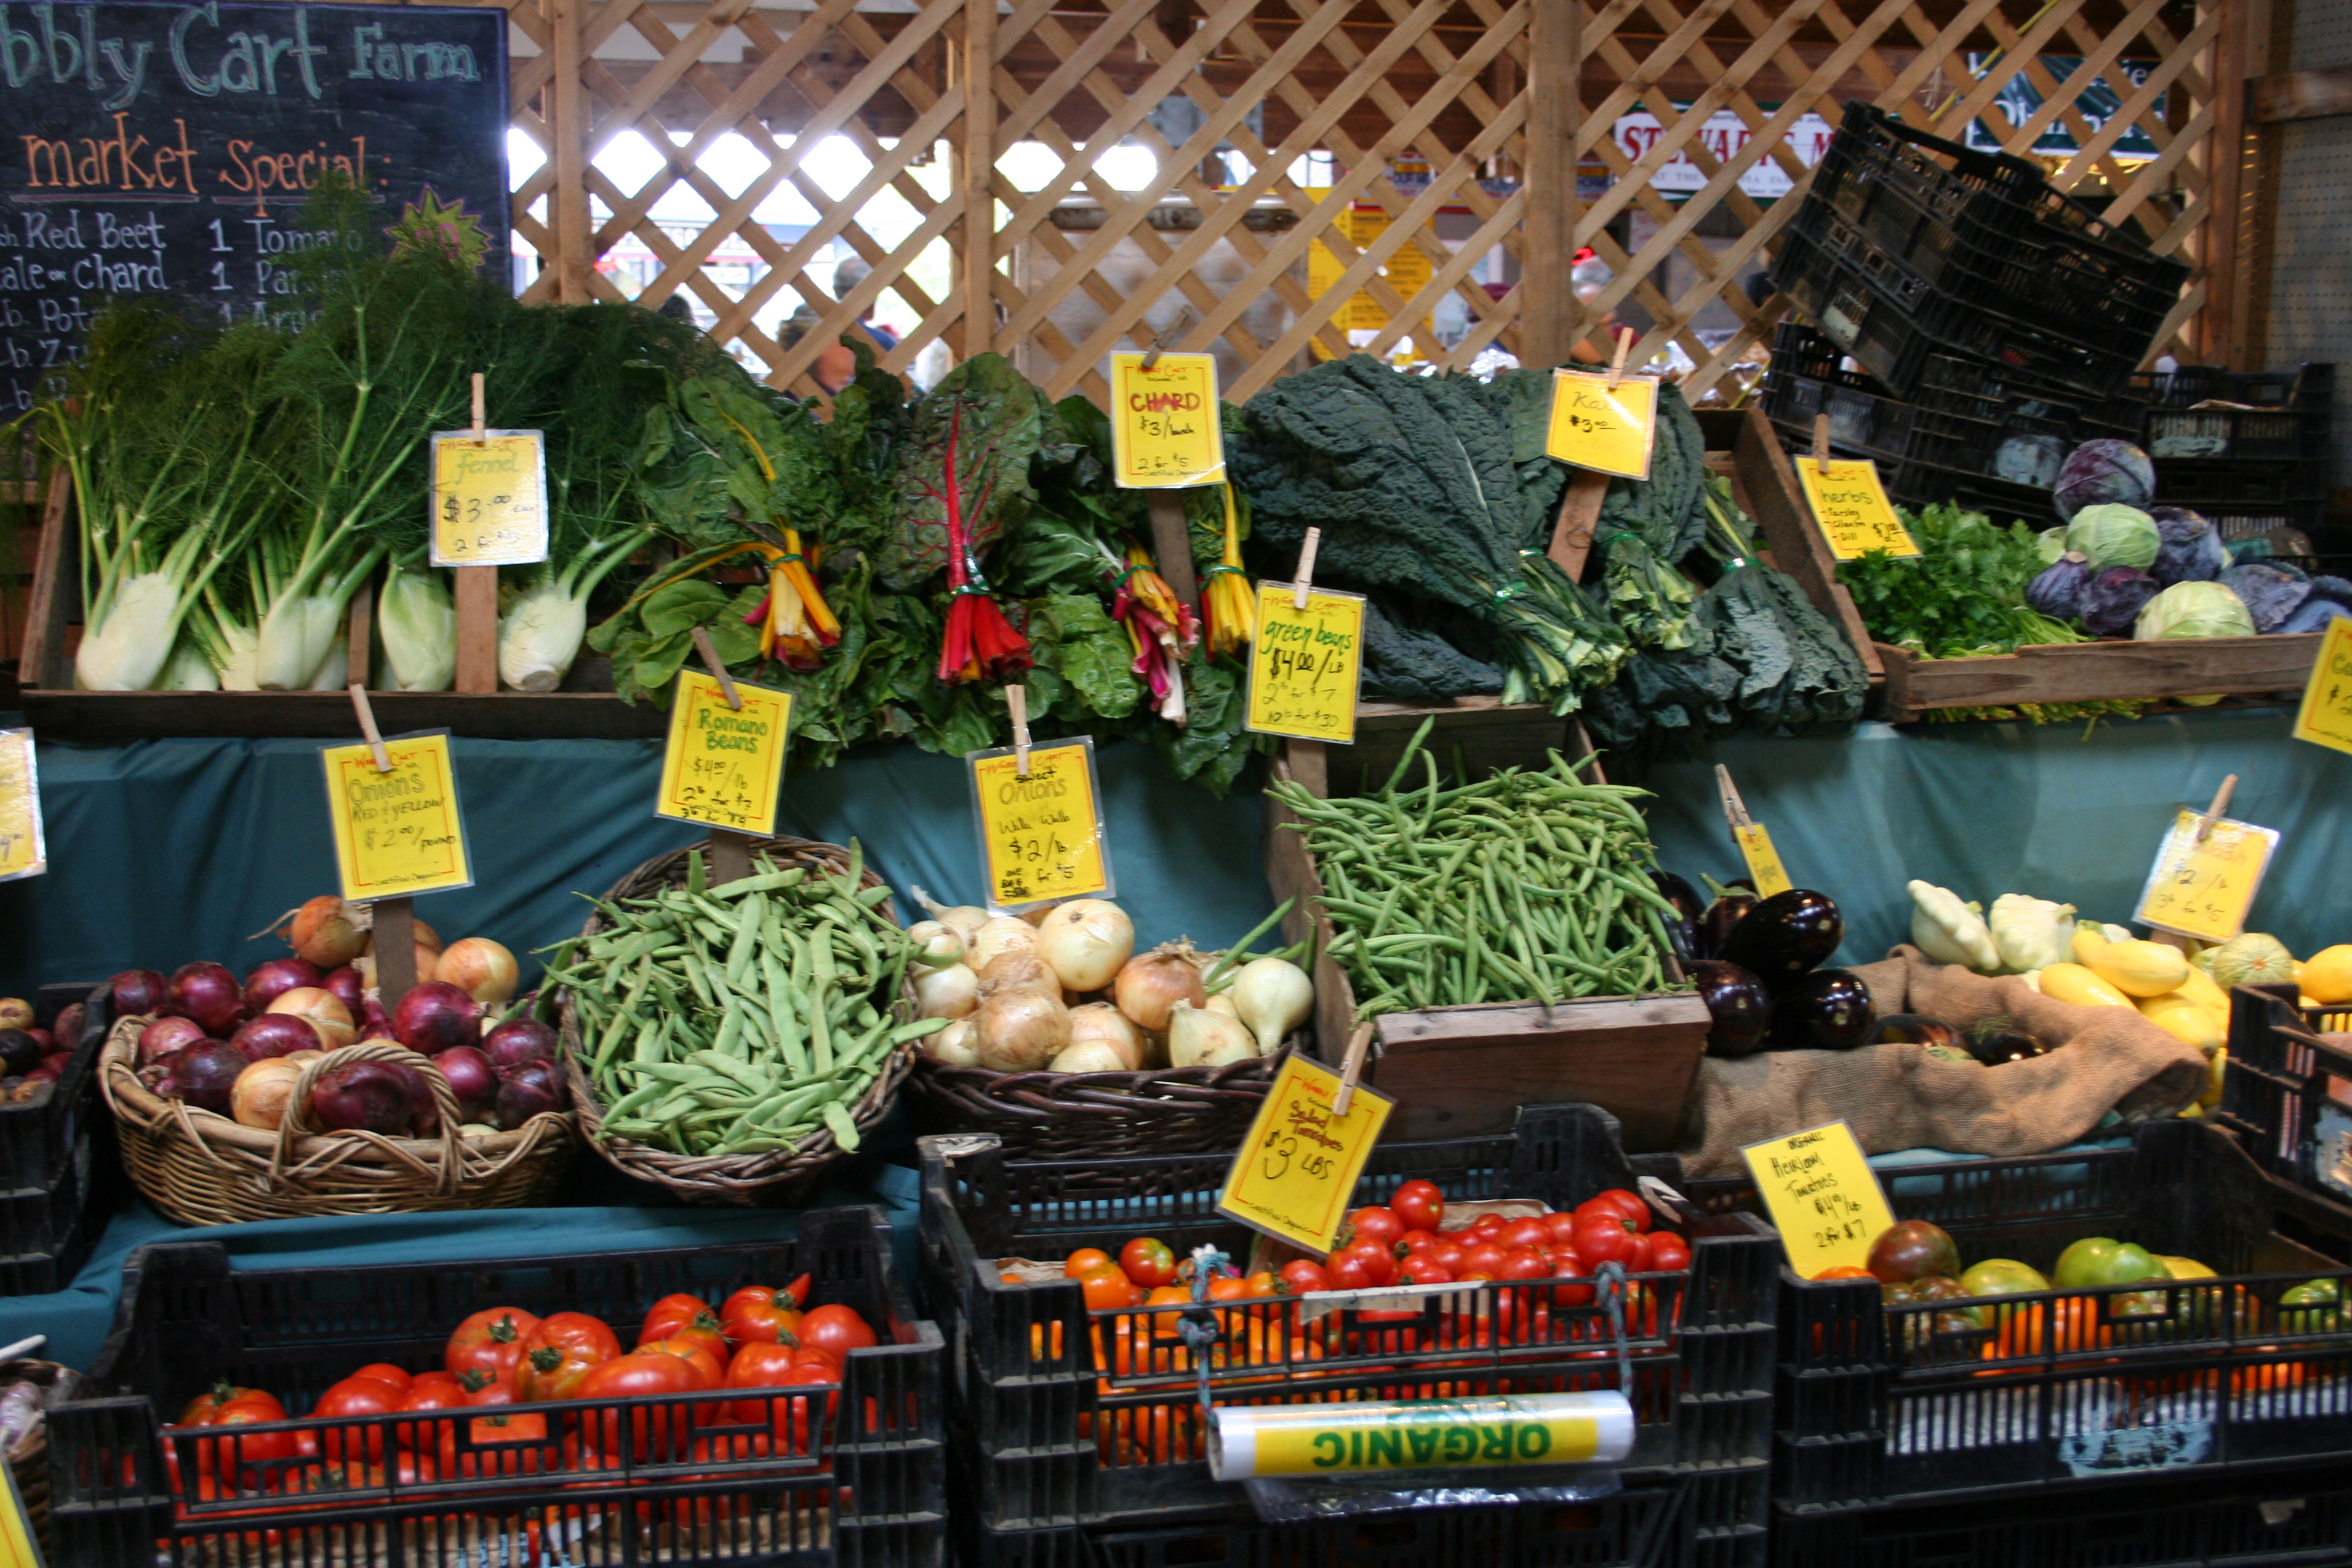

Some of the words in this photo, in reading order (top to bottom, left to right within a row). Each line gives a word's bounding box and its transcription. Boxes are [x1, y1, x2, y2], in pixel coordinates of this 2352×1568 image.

[169, 0, 327, 99] Cart
[348, 22, 481, 82] Farm
[19, 111, 199, 194] market
[21, 208, 86, 250] Red
[95, 210, 168, 250] Beet
[208, 218, 234, 252] 1
[72, 249, 170, 293] Chard
[211, 260, 233, 291] 1
[1130, 391, 1201, 412] CHARD
[1138, 458, 1149, 470] 2
[1819, 489, 1874, 505] herbs
[1839, 532, 1858, 542] Dill
[1260, 620, 1313, 655] green
[1315, 617, 1354, 656] beans
[697, 708, 769, 736] Romano
[706, 730, 759, 754] Beans
[348, 773, 425, 806] Onions
[999, 778, 1068, 805] Onions
[1301, 1153, 1335, 1180] LBS
[1815, 1231, 1828, 1247] 2
[1311, 1423, 1552, 1467] ORGANIC
